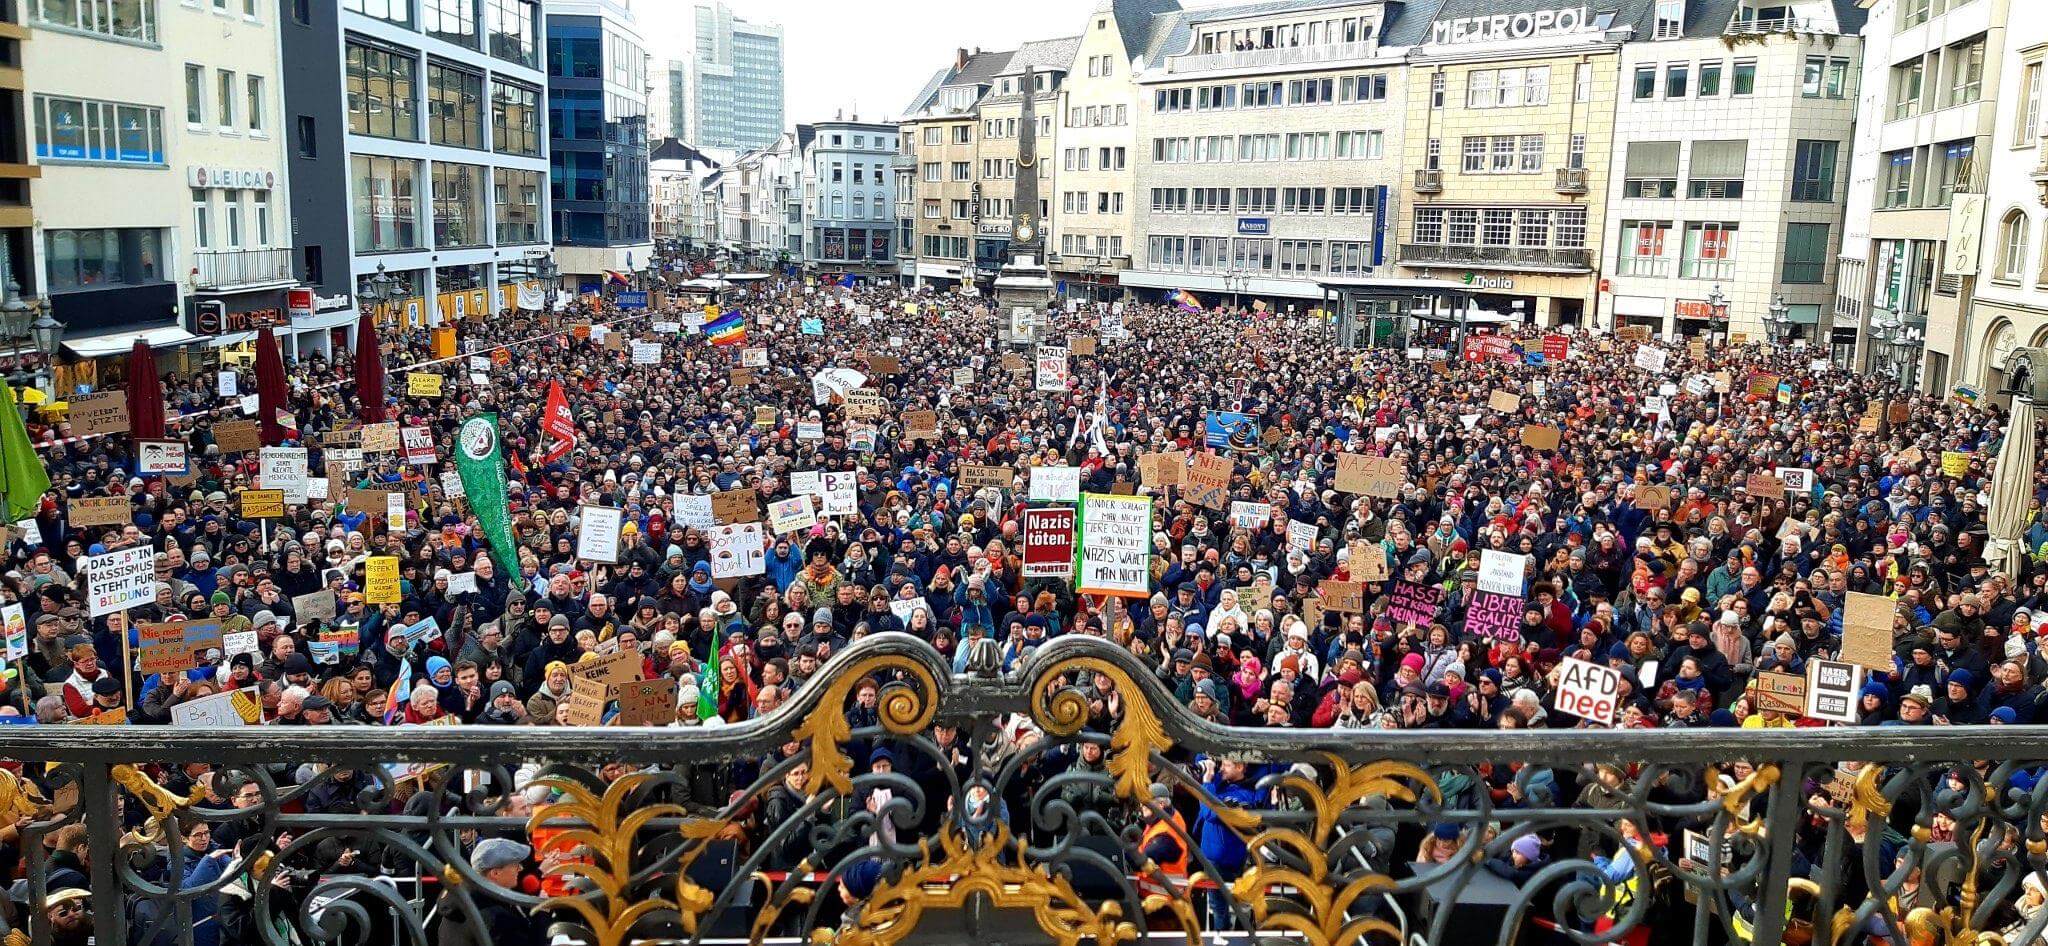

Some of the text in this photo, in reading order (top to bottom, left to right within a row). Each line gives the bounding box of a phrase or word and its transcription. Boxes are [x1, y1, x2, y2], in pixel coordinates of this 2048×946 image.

[1431, 7, 1599, 45] METROPOL
[213, 170, 263, 185] LEICA
[1956, 198, 1977, 270] KINO
[1474, 276, 1512, 289] Thalia
[1039, 348, 1065, 358] NAZIS
[966, 469, 999, 477] HASS IST
[1338, 456, 1398, 475] NAZIS
[1785, 472, 1803, 480] FCK
[1785, 479, 1803, 487] NZS
[829, 502, 853, 512] bunt
[1086, 499, 1116, 510] KINDER
[1028, 514, 1071, 529] Nazis
[1102, 513, 1145, 522] MAN NICHT
[1239, 516, 1259, 527] BUNT
[1084, 522, 1109, 534] TIERE
[711, 531, 757, 549] Bonn ist
[1028, 531, 1069, 547] töten.
[1101, 536, 1143, 547] MAN NICHT
[91, 556, 114, 570] DAS
[139, 548, 151, 559] IN
[1083, 546, 1115, 563] NAZIS
[90, 560, 153, 583] RASSISMUS
[1035, 565, 1068, 573] PARTEI
[1096, 567, 1145, 584] MAN NICHT
[94, 572, 154, 596] STEHT FÜR
[100, 586, 150, 607] BILDUNG
[1395, 580, 1437, 604] HASS
[1391, 596, 1436, 616] IST KEINE
[142, 626, 160, 639] Nie
[1464, 619, 1519, 642] FCK AFD
[585, 667, 611, 679] KEINE
[1564, 662, 1616, 695] AfD
[1559, 688, 1611, 721] nee
